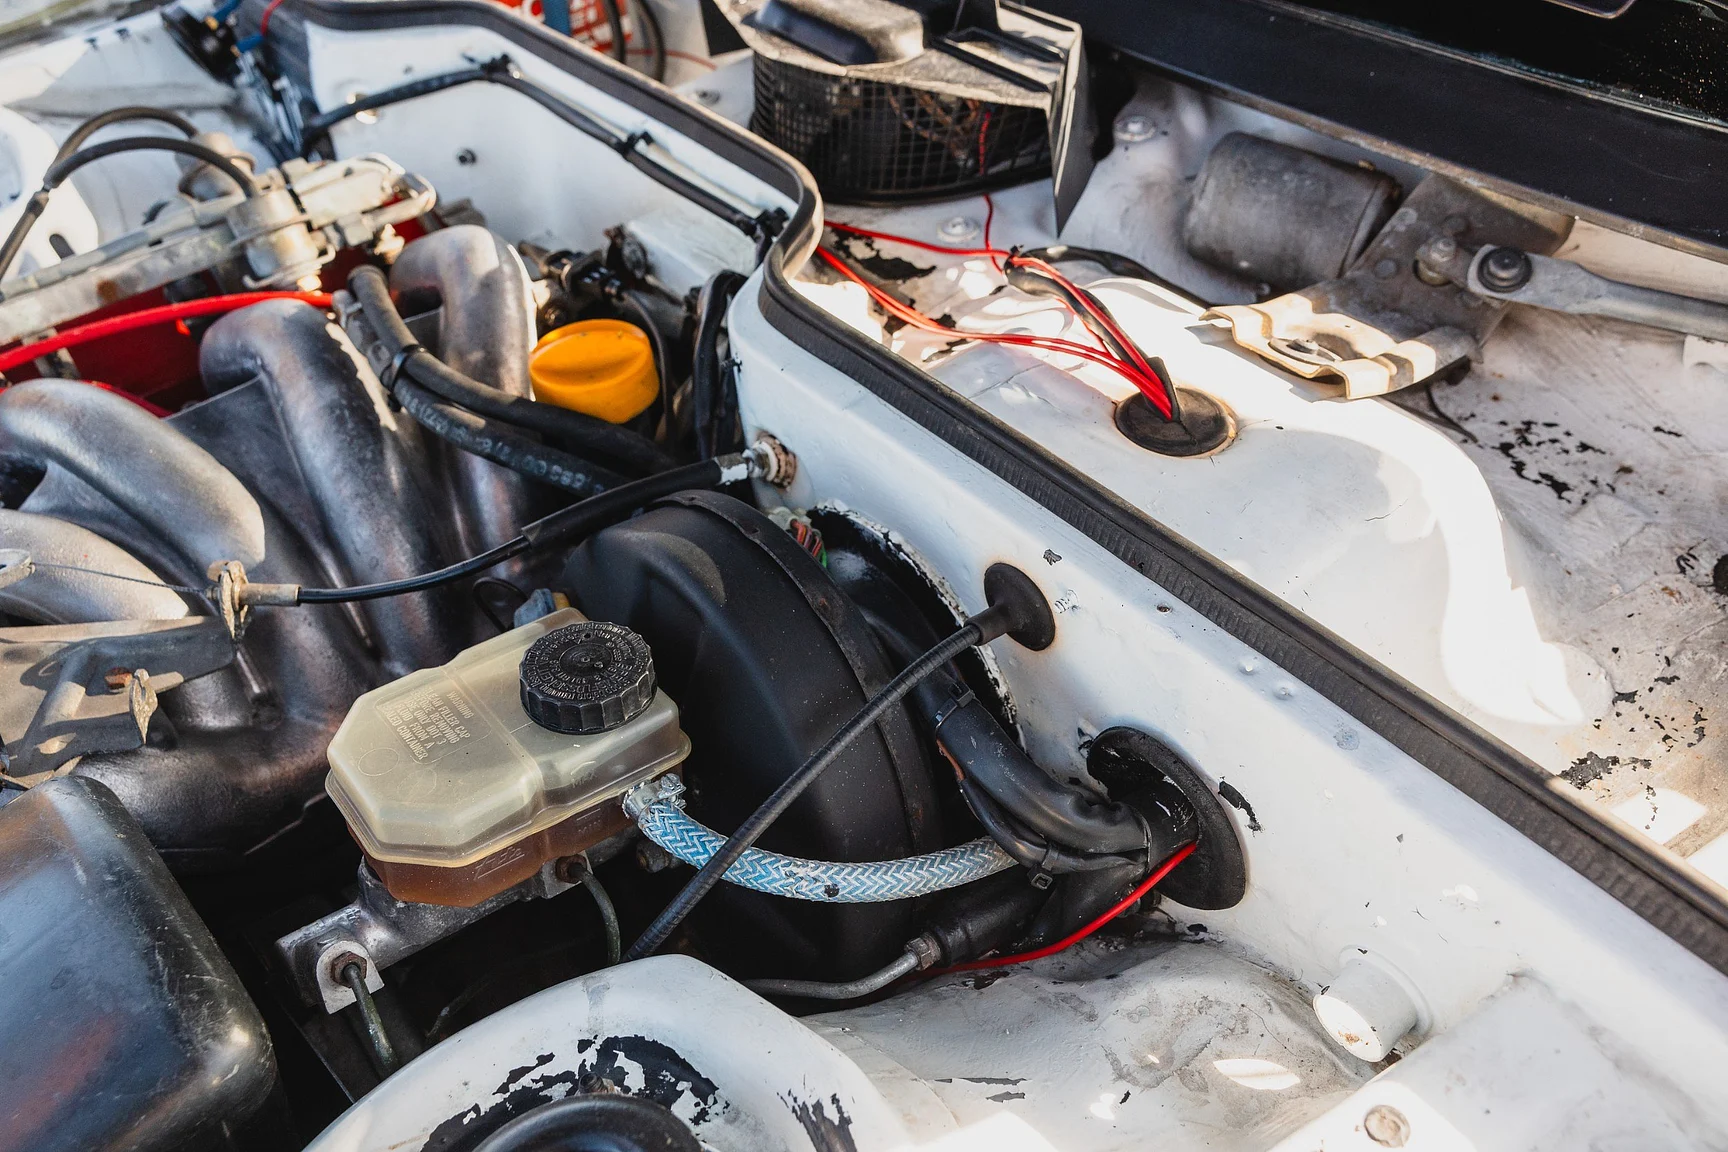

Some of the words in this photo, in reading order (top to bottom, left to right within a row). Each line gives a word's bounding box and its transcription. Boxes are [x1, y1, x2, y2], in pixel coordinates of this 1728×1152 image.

[447, 691, 474, 719] WARNING
[409, 721, 430, 741] FROM
[423, 741, 436, 750] A
[413, 708, 432, 725] ONLY
[426, 724, 443, 739] DOT
[429, 711, 460, 744] REMOVING
[437, 705, 460, 728] FILLER
[454, 725, 471, 739] CAP
[396, 725, 429, 761] CONTAINER
